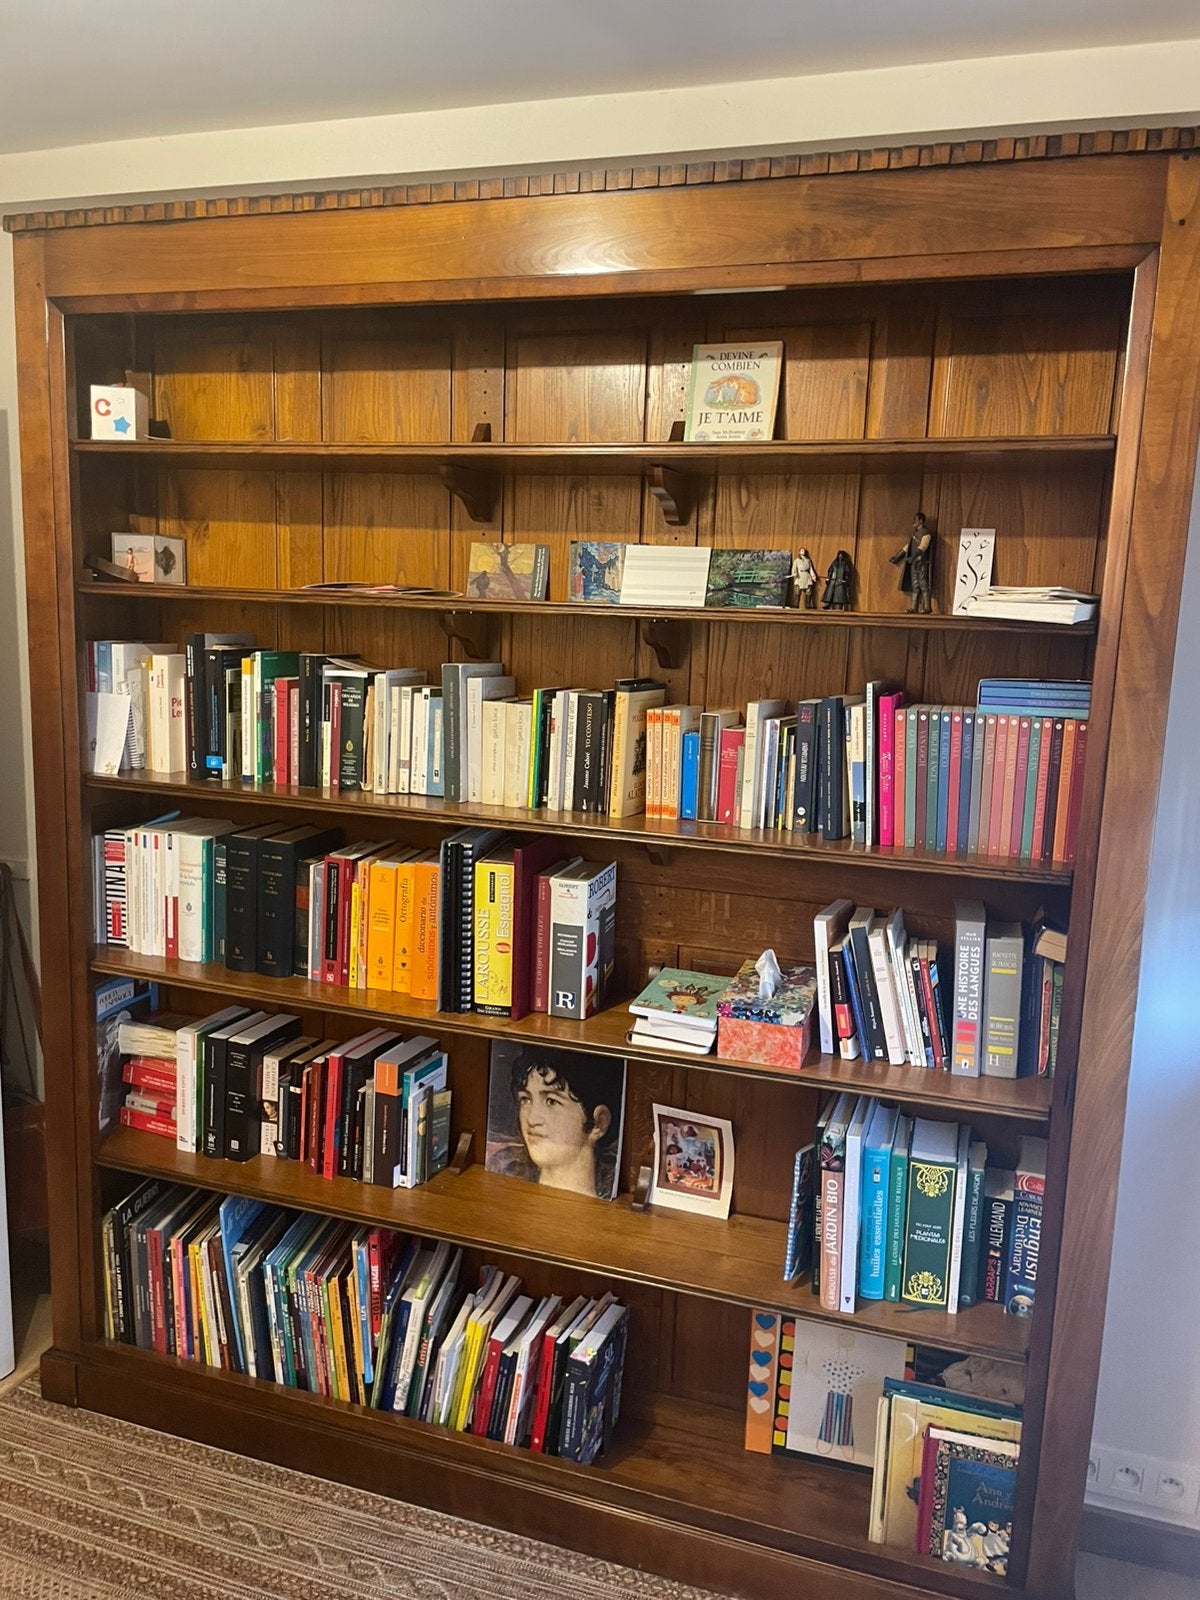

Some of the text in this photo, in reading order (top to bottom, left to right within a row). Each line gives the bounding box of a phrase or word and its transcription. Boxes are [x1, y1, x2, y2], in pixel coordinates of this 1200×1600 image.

[711, 361, 760, 371] COMBIEN
[720, 352, 754, 361] DEVINE
[697, 411, 764, 427] JE T'AIME
[584, 703, 592, 738] CONFIESO
[942, 731, 949, 741] EL
[585, 739, 591, 748] YO
[930, 729, 938, 759] MIGUEL
[963, 733, 971, 759] MONET
[428, 872, 439, 924] antónimos
[588, 869, 615, 899] ROBERT
[399, 878, 409, 923] Ortografía
[495, 872, 513, 938] Espagnol
[417, 897, 427, 953] diccionario de
[425, 931, 436, 980] sinónimos
[477, 907, 490, 1000] LAROUSSE
[957, 944, 970, 1020] UNE HISTOIRE
[968, 944, 981, 1021] DES LANGUES
[556, 990, 576, 1010] R
[122, 1207, 132, 1225] LA
[893, 1204, 901, 1228] JARDINS
[970, 1206, 980, 1230] FLEURS
[989, 1202, 1006, 1248] ALLEMAND
[826, 1179, 839, 1306] LAROUSSE du JARDIN BIO
[869, 1190, 884, 1279] huiles essentielles
[968, 1230, 977, 1243] LES
[1008, 1215, 1028, 1277] Dictionary
[984, 1258, 997, 1300] HARRAP'S
[977, 1481, 1003, 1497] Ana
